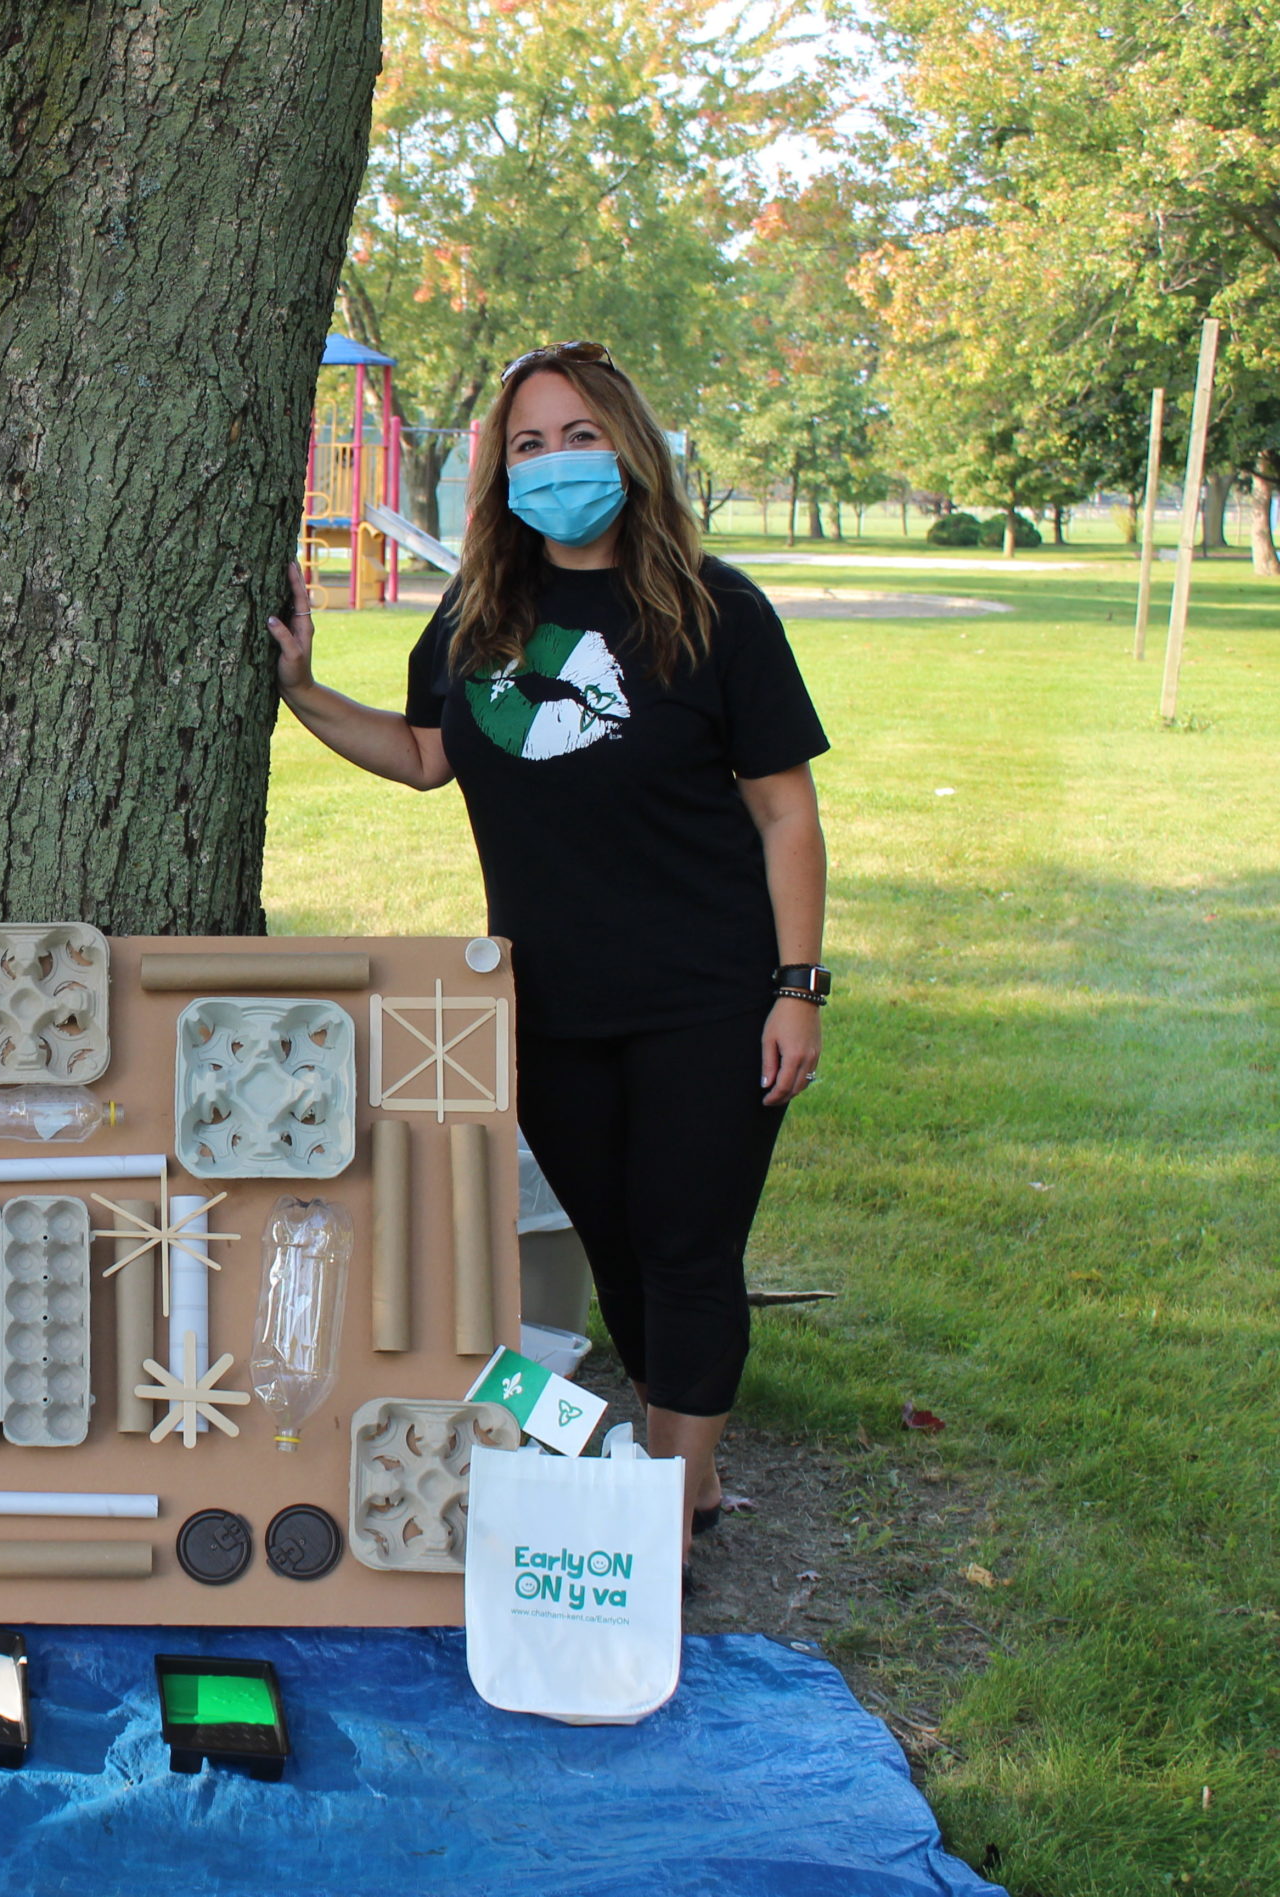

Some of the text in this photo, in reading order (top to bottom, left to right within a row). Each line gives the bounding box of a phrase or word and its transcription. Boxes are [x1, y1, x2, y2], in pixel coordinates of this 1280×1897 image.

[515, 1572, 627, 1611] ON y va
